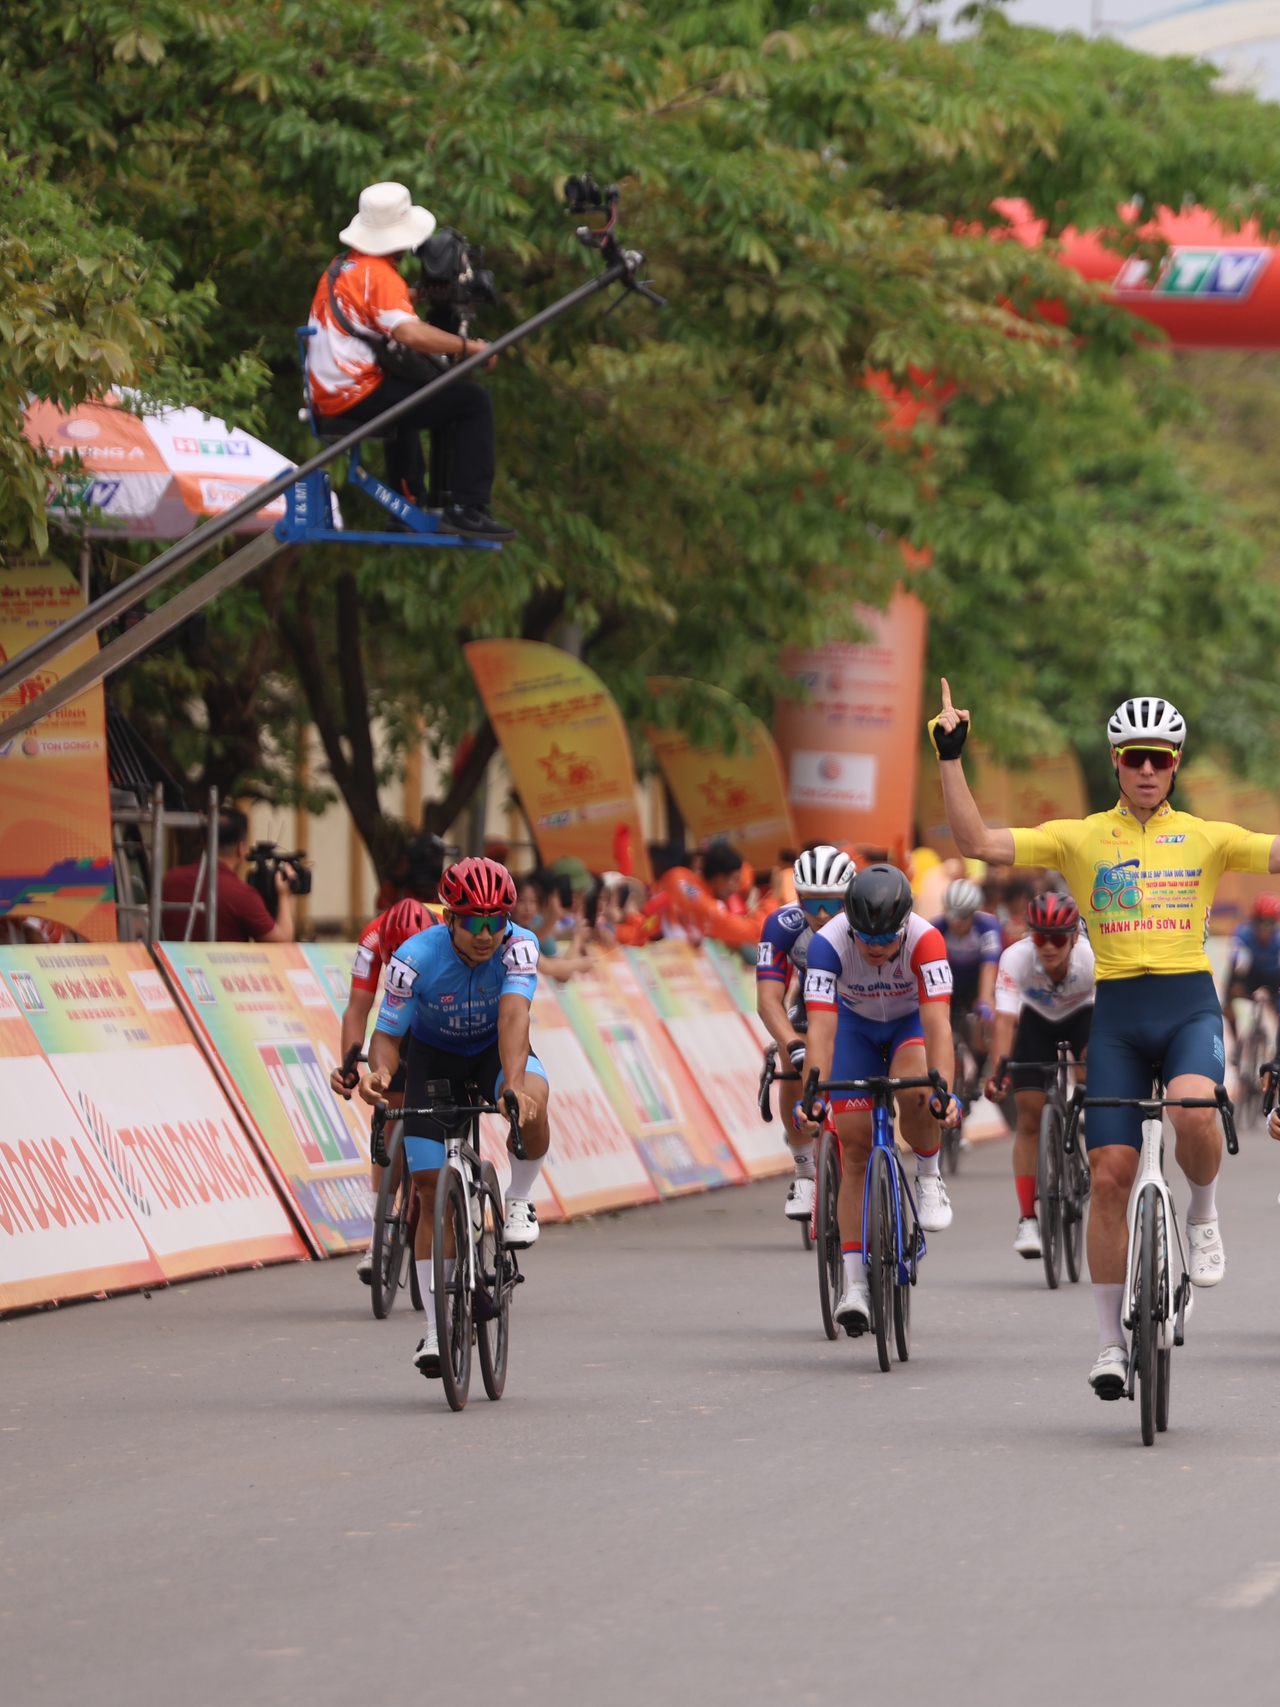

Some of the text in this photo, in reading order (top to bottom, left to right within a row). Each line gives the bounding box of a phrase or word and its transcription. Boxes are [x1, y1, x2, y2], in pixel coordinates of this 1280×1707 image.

[174, 437, 249, 455] HTV
[1156, 834, 1185, 844] HTV
[1099, 915, 1191, 934] THÀNH PHỐ SƠN LA
[511, 946, 533, 965] 11
[390, 965, 405, 989] 11
[806, 975, 834, 994] 117
[884, 987, 913, 997] LONG
[461, 1000, 486, 1009] MINH
[262, 1050, 355, 1157] HTV
[116, 1124, 197, 1212] TON
[161, 1118, 251, 1204] DONG
[218, 1117, 270, 1197] A
[0, 1136, 100, 1230] DONG
[69, 1135, 124, 1221] A
